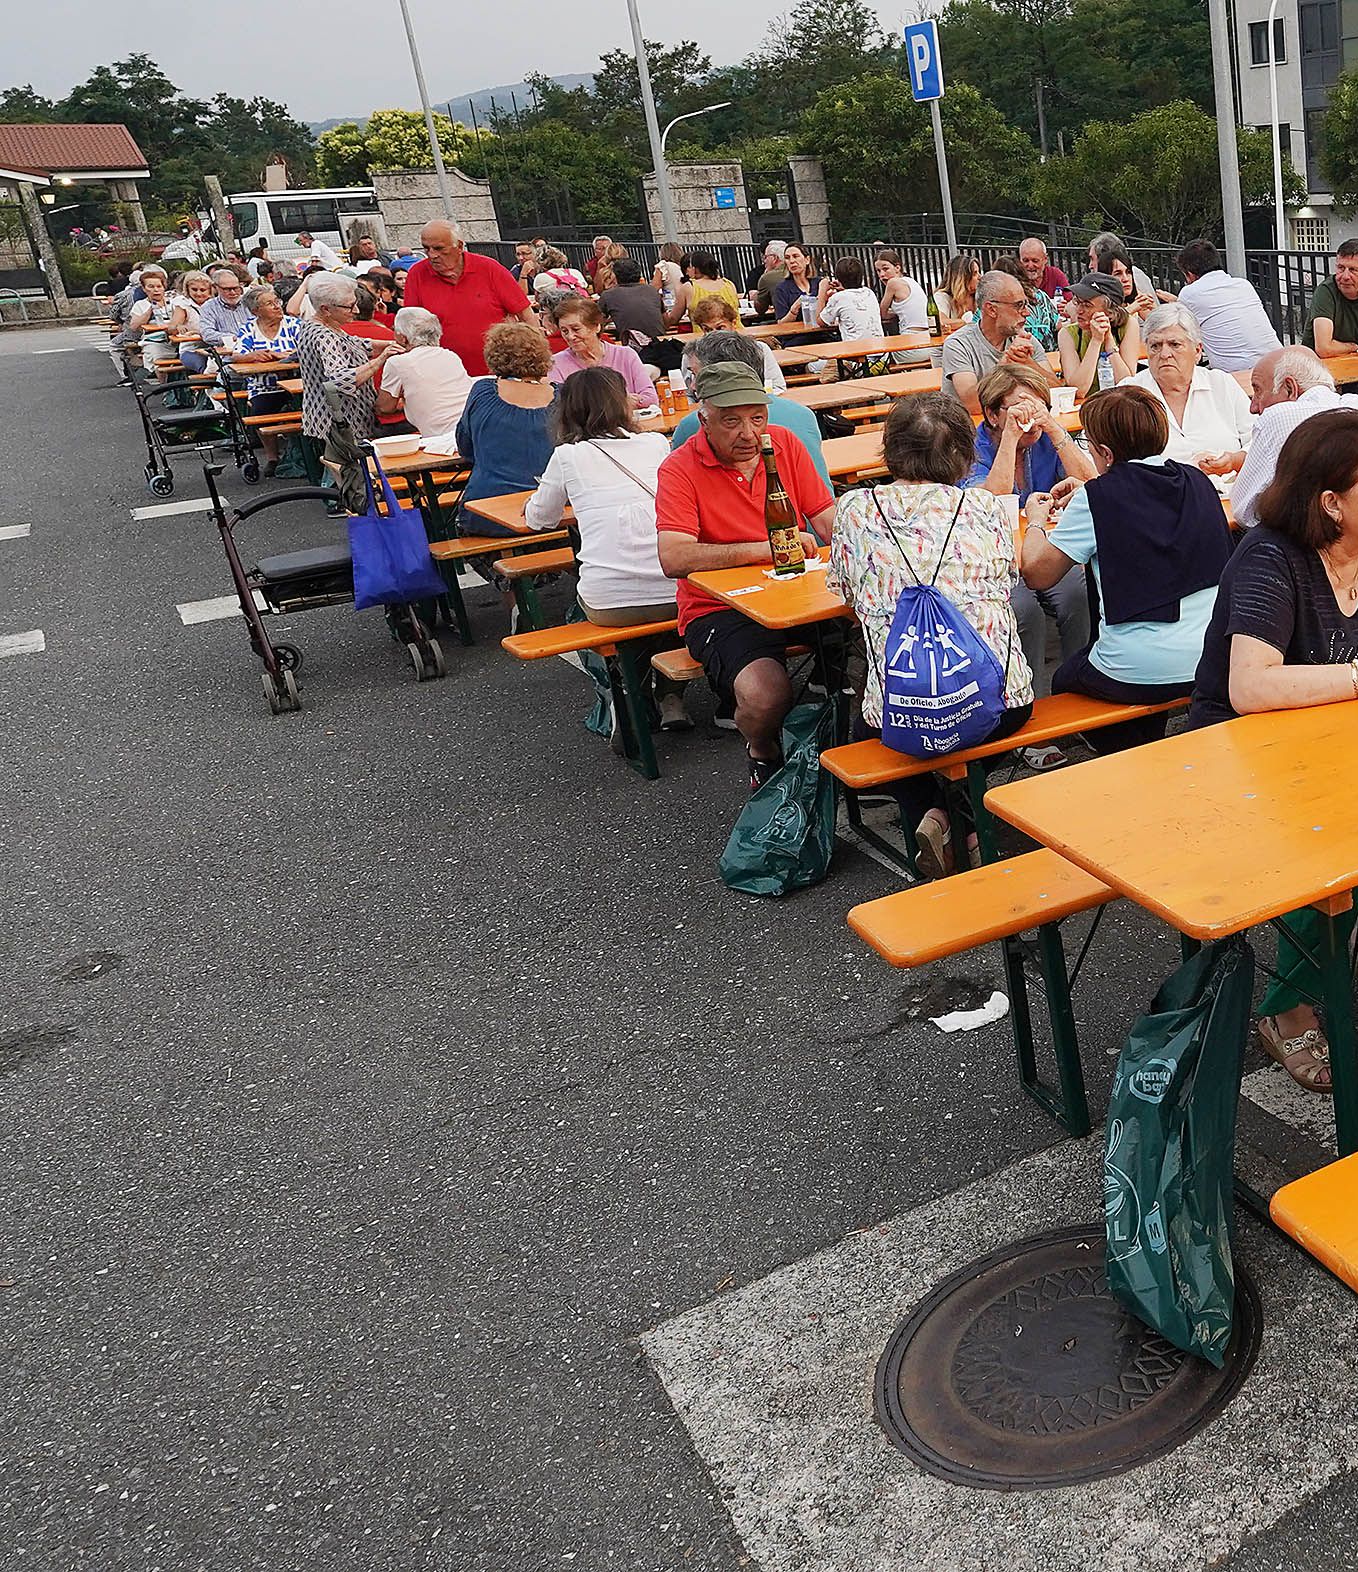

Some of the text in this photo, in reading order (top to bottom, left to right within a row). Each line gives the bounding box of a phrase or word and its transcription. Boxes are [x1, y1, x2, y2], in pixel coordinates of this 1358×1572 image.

[911, 33, 930, 90] P
[900, 697, 909, 705] De
[938, 691, 966, 706] Abogado
[889, 712, 906, 728] 12
[1136, 1069, 1171, 1085] handy
